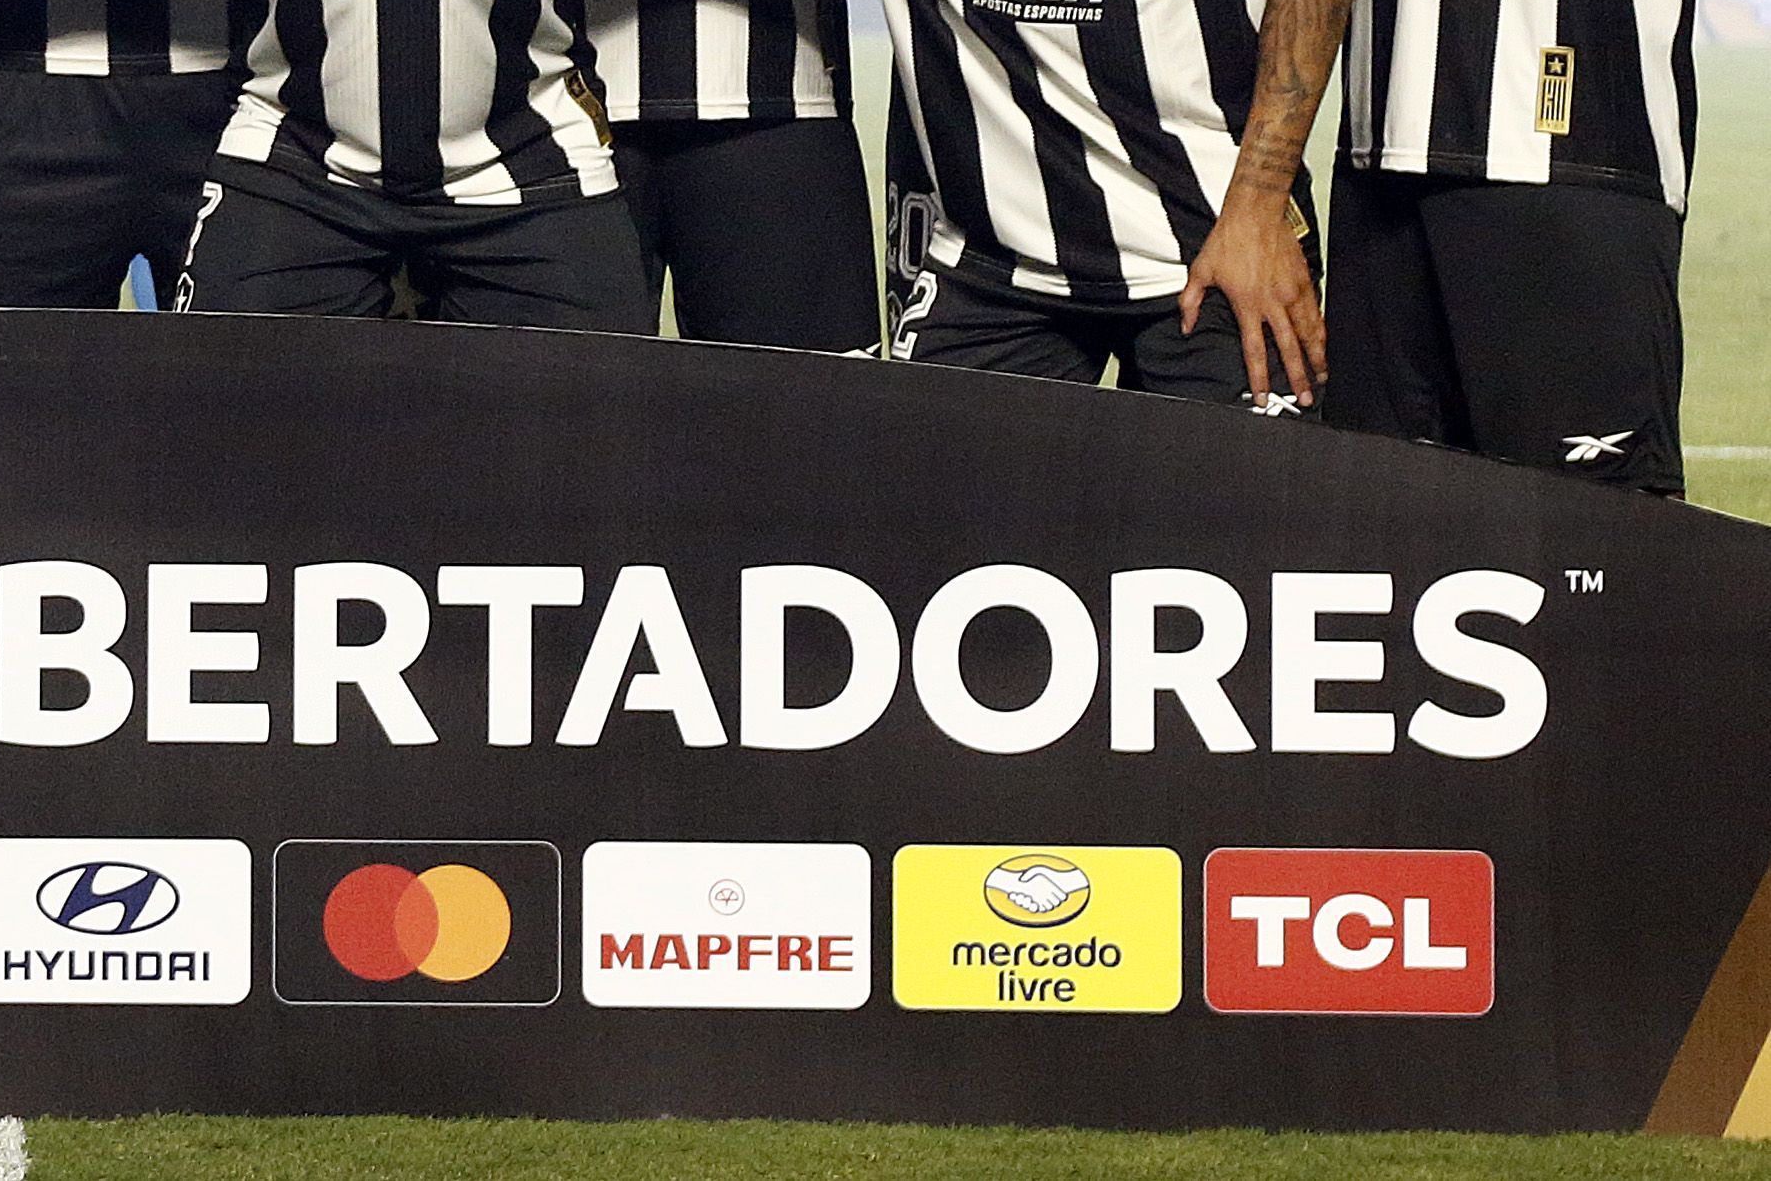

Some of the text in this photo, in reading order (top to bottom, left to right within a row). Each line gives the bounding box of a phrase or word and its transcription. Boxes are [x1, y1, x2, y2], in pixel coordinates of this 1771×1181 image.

[1023, 3, 1103, 22] ESPORTIVAS
[1230, 893, 1468, 971] TCL
[3, 950, 212, 982] HYUNDAI
[599, 932, 855, 973] MAPFRE
[952, 936, 1122, 969] mercado
[997, 970, 1077, 1003] livre
